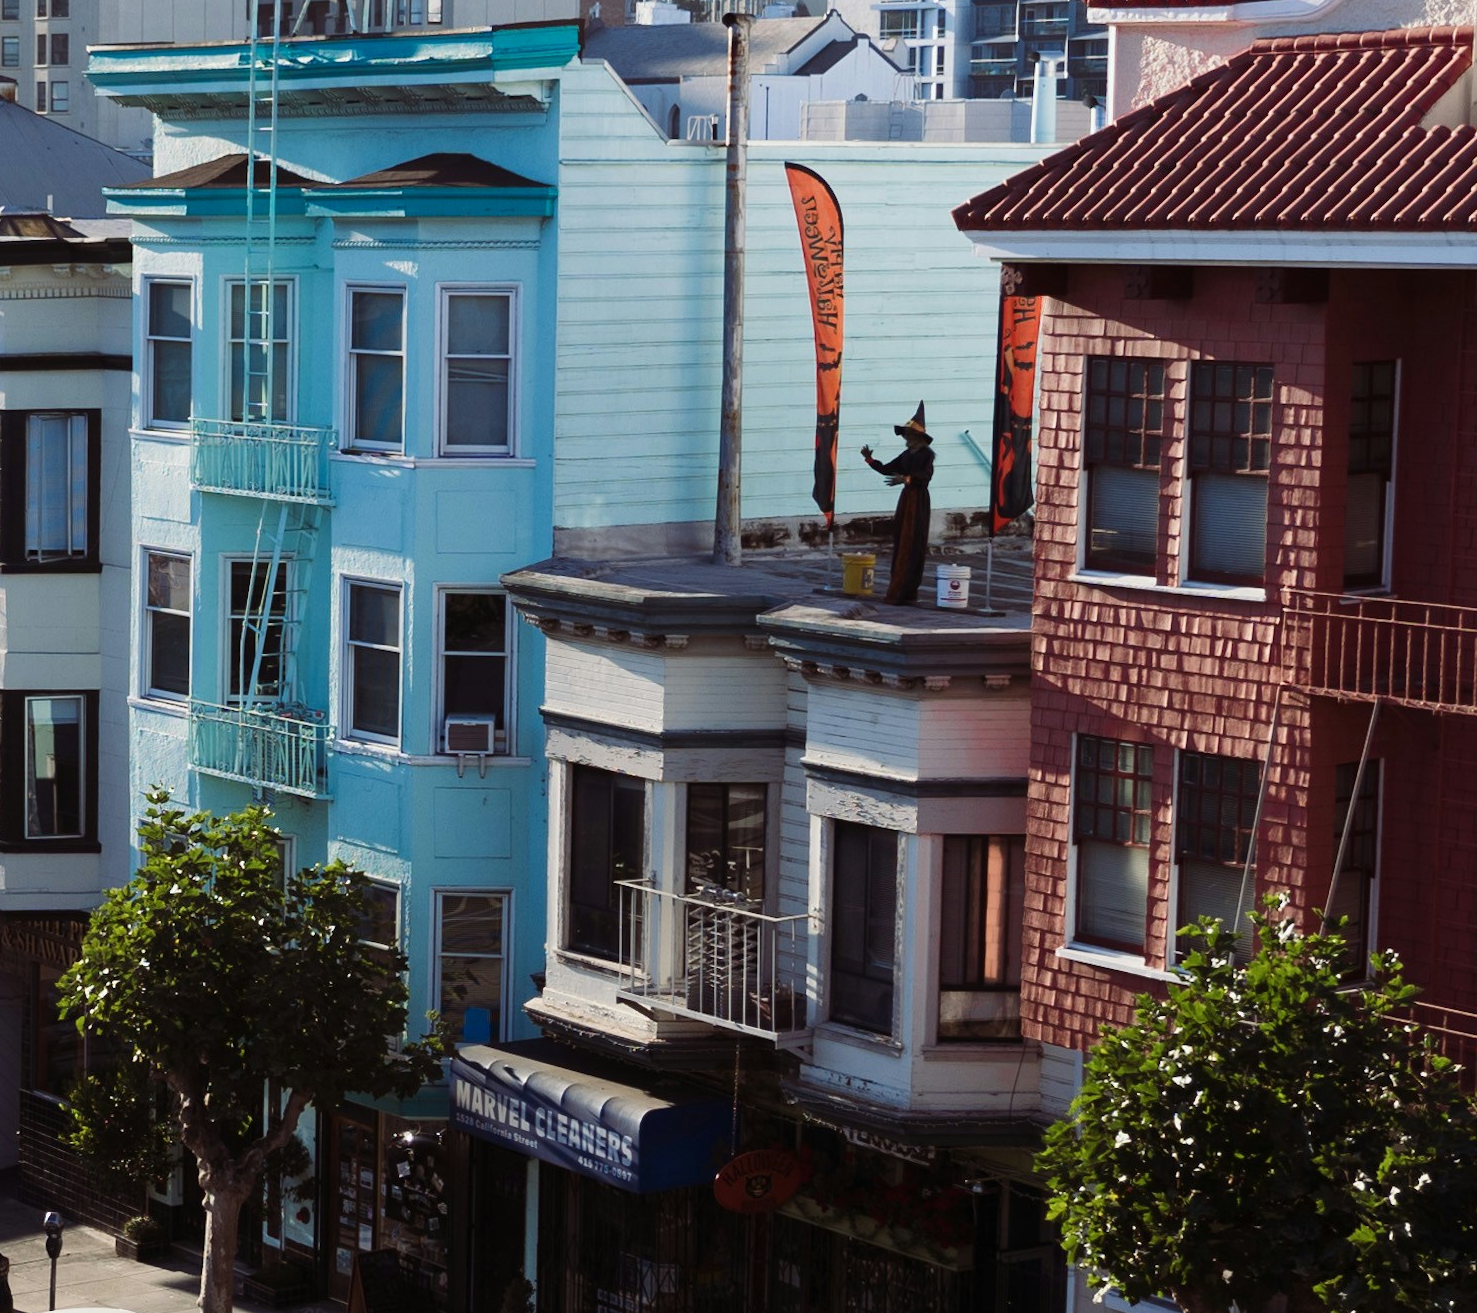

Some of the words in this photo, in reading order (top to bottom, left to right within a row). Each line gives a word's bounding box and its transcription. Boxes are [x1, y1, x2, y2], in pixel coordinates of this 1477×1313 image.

[456, 1078, 531, 1132] MARVEL
[534, 1106, 633, 1167] CLEANERS
[475, 1116, 512, 1140] California
[513, 1132, 538, 1150] Street
